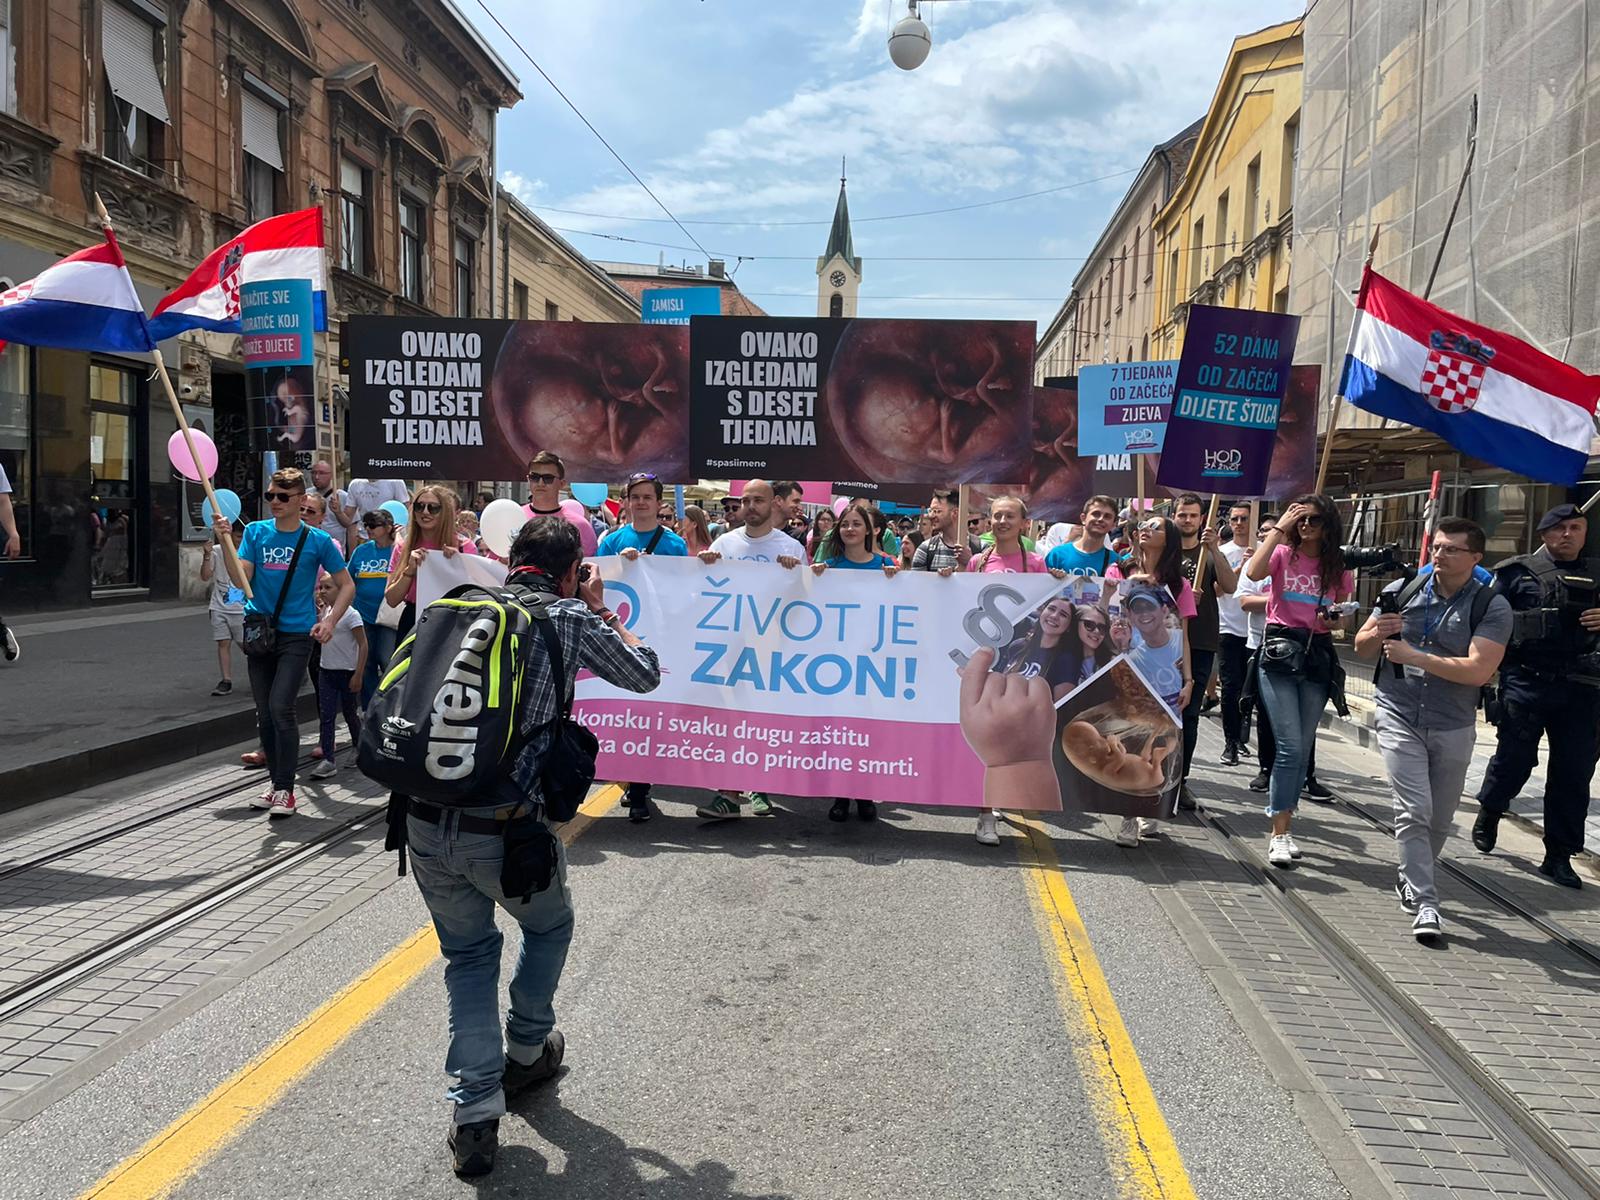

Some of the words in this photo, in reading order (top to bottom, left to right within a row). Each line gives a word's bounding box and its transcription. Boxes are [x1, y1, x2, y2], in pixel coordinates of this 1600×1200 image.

[272, 290, 290, 304] SVE
[651, 298, 684, 312] ZAMISLI
[278, 314, 299, 328] KOJI
[265, 338, 294, 353] DIJETE
[401, 330, 482, 358] OVAKO
[740, 330, 818, 358] OVAKO
[1214, 333, 1238, 355] 52
[1240, 336, 1279, 360] DANA
[365, 359, 482, 388] IZGLEDAM
[705, 360, 818, 388] IZGLEDAM
[1111, 368, 1118, 382] 7
[1121, 365, 1173, 381] TJEDANA
[1197, 364, 1222, 387] OD
[1225, 366, 1279, 393] ZAČEĆA
[389, 389, 405, 415] S
[411, 390, 483, 417] DESET
[727, 389, 743, 416] S
[748, 390, 818, 417] DESET
[1110, 386, 1126, 401] OD
[1129, 381, 1175, 400] ZAČEĆA
[1122, 406, 1162, 422] ZIJEVA
[1179, 395, 1238, 422] DIJETE
[1239, 398, 1278, 424] ŠTUCA
[381, 418, 484, 446] TJEDANA
[720, 419, 817, 446] TJEDANA
[1124, 428, 1153, 444] HOD
[368, 458, 432, 468] #spasiimene
[706, 458, 767, 468] #spasiimene
[1095, 453, 1132, 471] ANA
[1204, 449, 1242, 465] HOD
[695, 575, 861, 643] ŽIVOT
[871, 604, 919, 653] JE
[690, 641, 918, 700] ZAKON!
[424, 618, 497, 780] arena
[656, 711, 663, 730] i
[668, 716, 727, 738] svaku
[733, 720, 793, 747] drugu
[799, 725, 870, 747] zaštitu
[622, 736, 651, 756] od
[655, 739, 726, 763] začeća
[731, 745, 759, 765] do
[764, 750, 853, 772] prirodne
[858, 757, 919, 777] smrti.
